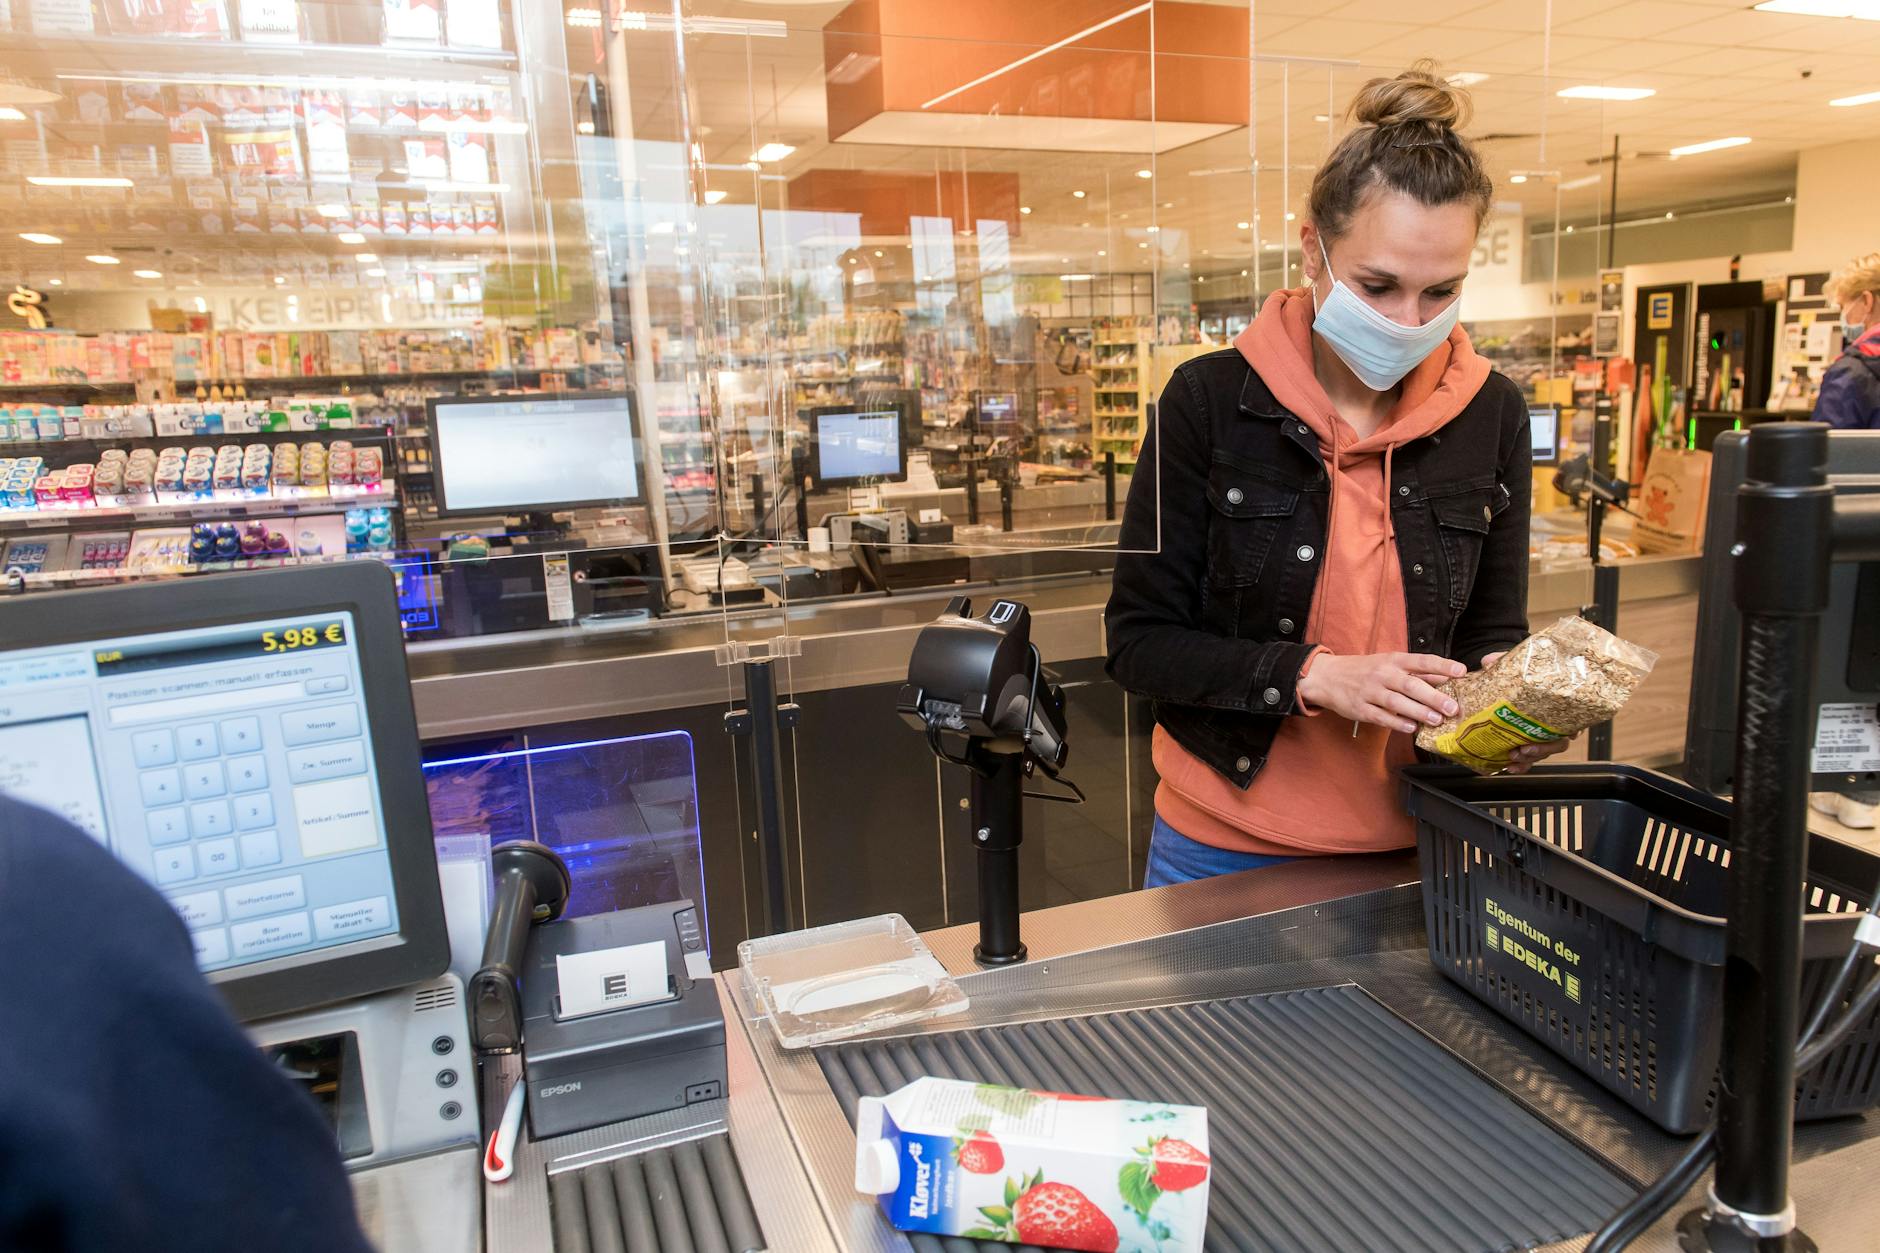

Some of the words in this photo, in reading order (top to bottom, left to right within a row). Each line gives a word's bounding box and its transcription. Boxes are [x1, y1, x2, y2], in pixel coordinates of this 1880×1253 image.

[261, 627, 318, 653] 5,98
[325, 624, 343, 643] €
[96, 651, 122, 663] EUR
[107, 686, 157, 700] Position
[265, 666, 313, 680] erfassen
[1486, 897, 1551, 949] Eigentum
[1555, 941, 1580, 966] der
[1503, 935, 1562, 987] EDEKA
[604, 974, 627, 995] E
[541, 1081, 581, 1098] EPSON
